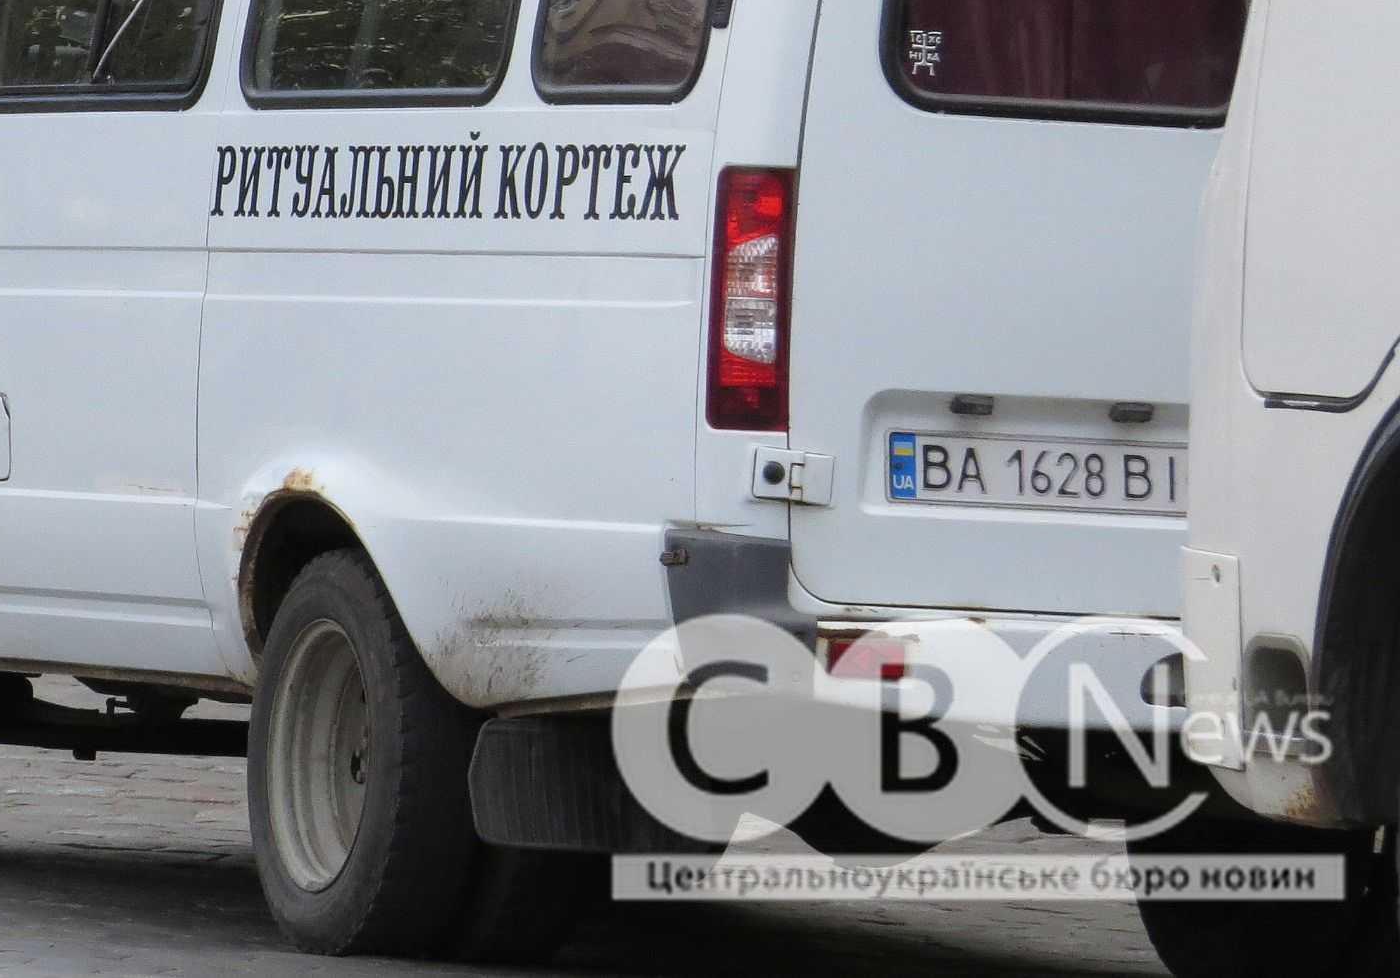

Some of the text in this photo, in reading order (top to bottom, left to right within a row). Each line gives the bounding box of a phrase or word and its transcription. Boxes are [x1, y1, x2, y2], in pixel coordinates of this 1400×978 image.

[210, 130, 687, 220] РИТУАЛЬНИЙ КОРТЕЖ
[893, 474, 914, 490] UA
[921, 444, 988, 494] BA
[1006, 448, 1106, 498] 1628
